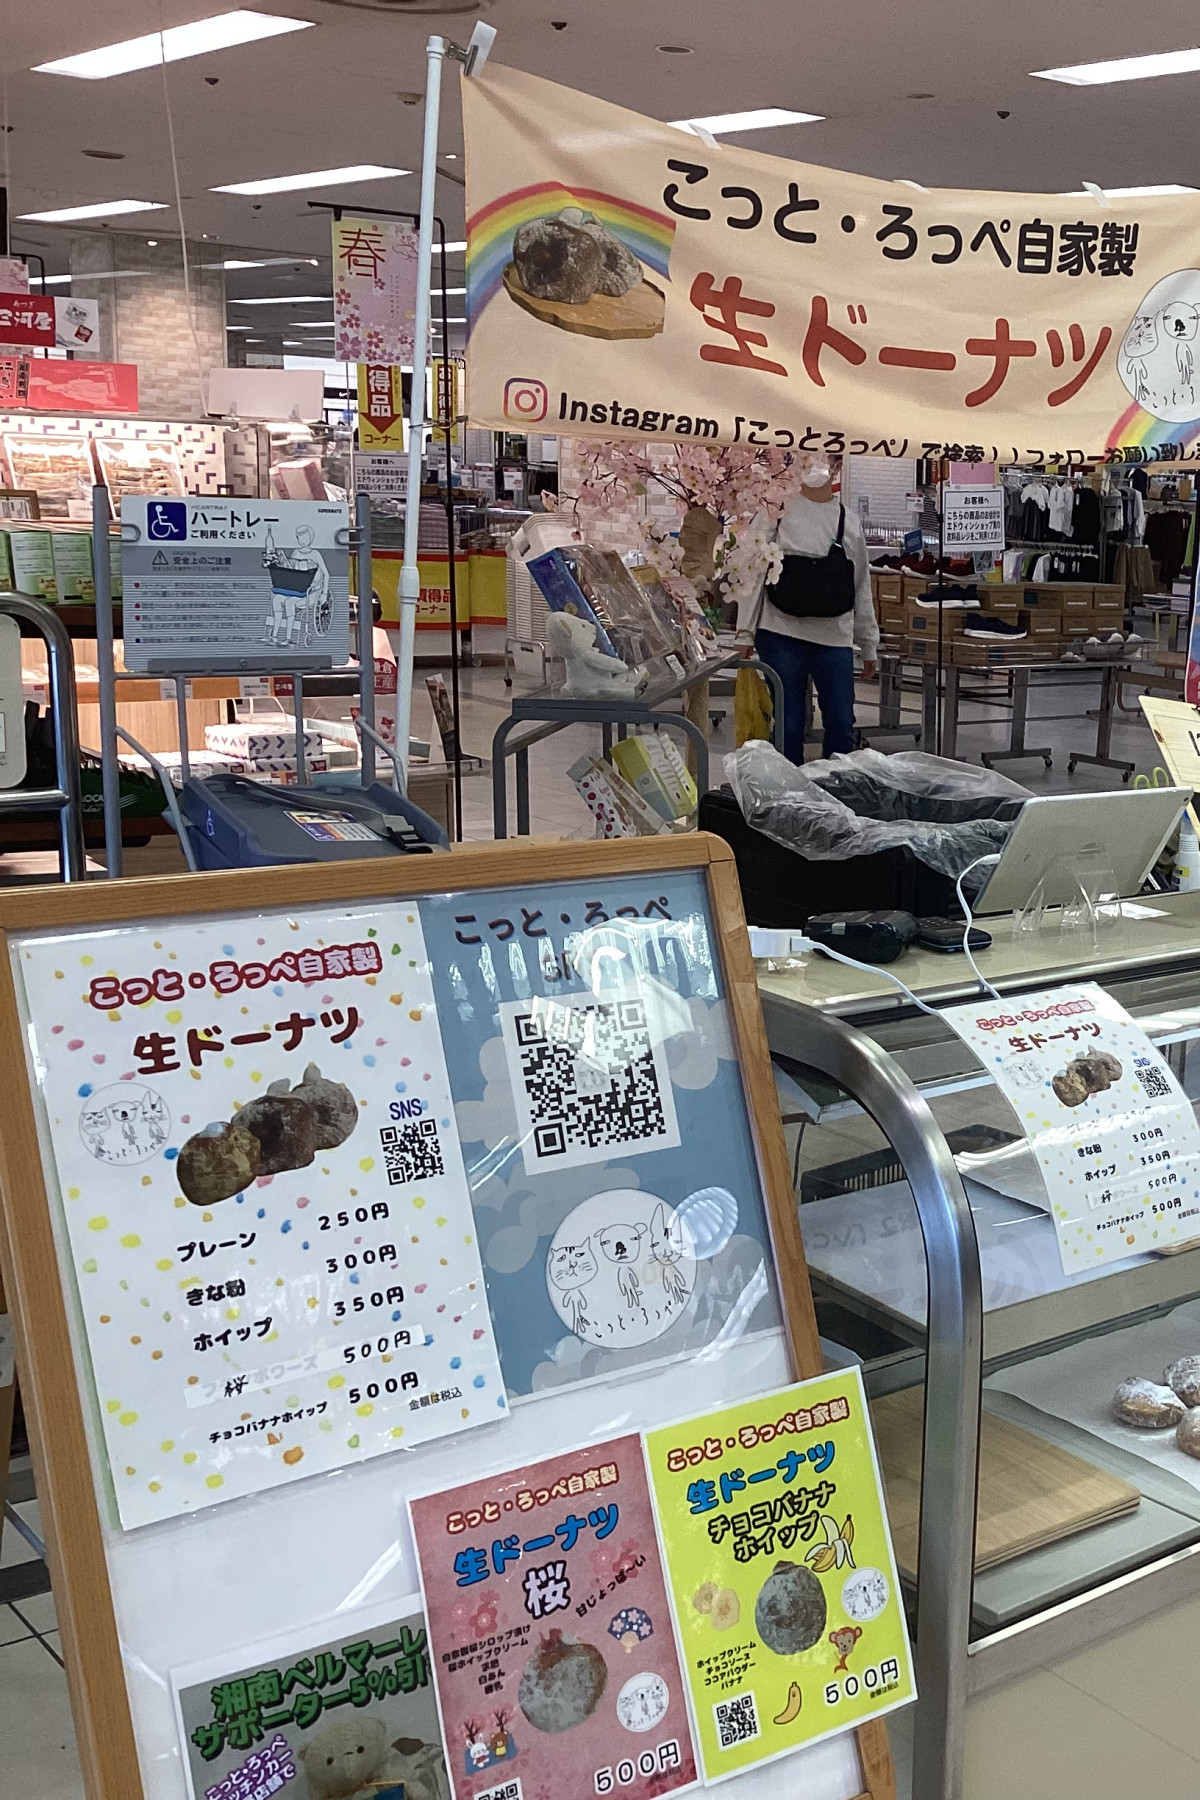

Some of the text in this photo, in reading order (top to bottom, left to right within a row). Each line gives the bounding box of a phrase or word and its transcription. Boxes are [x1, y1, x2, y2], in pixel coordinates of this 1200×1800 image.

[662, 158, 1139, 278] こっと・ろっぺ自家製
[338, 228, 387, 280] 春
[689, 270, 1113, 409] 生ドーナツ
[364, 433, 399, 445] コーナー
[558, 392, 719, 439] Instagram
[190, 529, 256, 540] ご利用ください
[191, 510, 280, 528] ハートレー
[172, 556, 232, 566] 安全上のご注意
[454, 895, 672, 944] こっと・ろっぺ
[88, 941, 383, 1010] こっと・ろっぺ自家製
[132, 1006, 359, 1075] 生ドーナツ
[1008, 1022, 1101, 1053] 生ドーナツ
[1133, 1057, 1151, 1068] SNS
[389, 1098, 424, 1120] SNS
[1132, 1127, 1164, 1143] 300円
[1084, 1150, 1171, 1182] ホイップ 350円
[177, 1202, 390, 1262] プレーン 250円
[1096, 1197, 1182, 1231] チョコバナナホイップ 500円
[185, 1244, 398, 1306] きな粉 300円
[193, 1286, 405, 1352] ホイップ 350円
[343, 1330, 412, 1365] 500円
[208, 1371, 420, 1444] チョコバナナホイップ 500円
[408, 1386, 463, 1412] 金額は税込
[667, 1398, 850, 1473] こっと・ろっぺ自家製
[446, 1462, 620, 1535] こっと・ろっぺ自家製
[686, 1440, 836, 1515] 生ドーナツ
[708, 1481, 837, 1544] チョコバナナ
[454, 1502, 620, 1588] 生ドーナツ
[734, 1514, 821, 1564] ホイップ
[522, 1559, 572, 1620] 桜
[211, 1625, 426, 1721] 湘南ベルマーレ
[696, 1641, 757, 1668] ホイップクリーム
[825, 1658, 899, 1704] 500円
[596, 1741, 679, 1792] 500円
